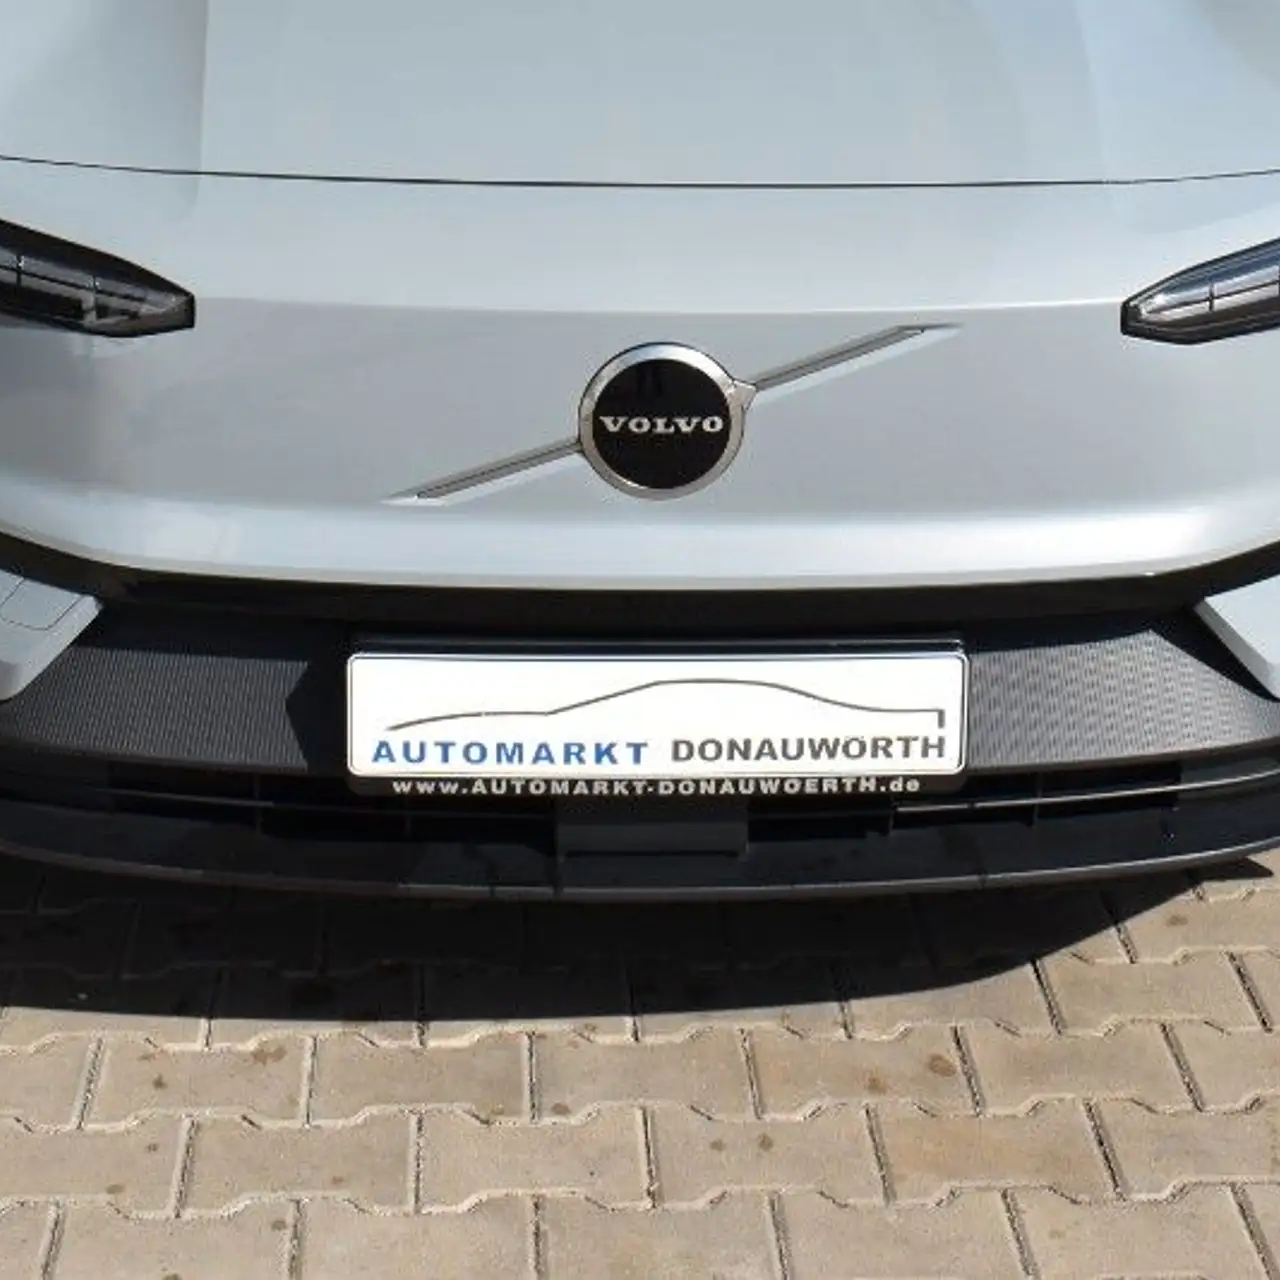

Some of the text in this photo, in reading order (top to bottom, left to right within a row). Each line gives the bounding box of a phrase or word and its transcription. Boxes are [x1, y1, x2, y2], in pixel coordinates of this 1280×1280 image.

[598, 416, 724, 434] VOLVO
[372, 735, 946, 766] AUTOMARKT DONAUWÖRTH
